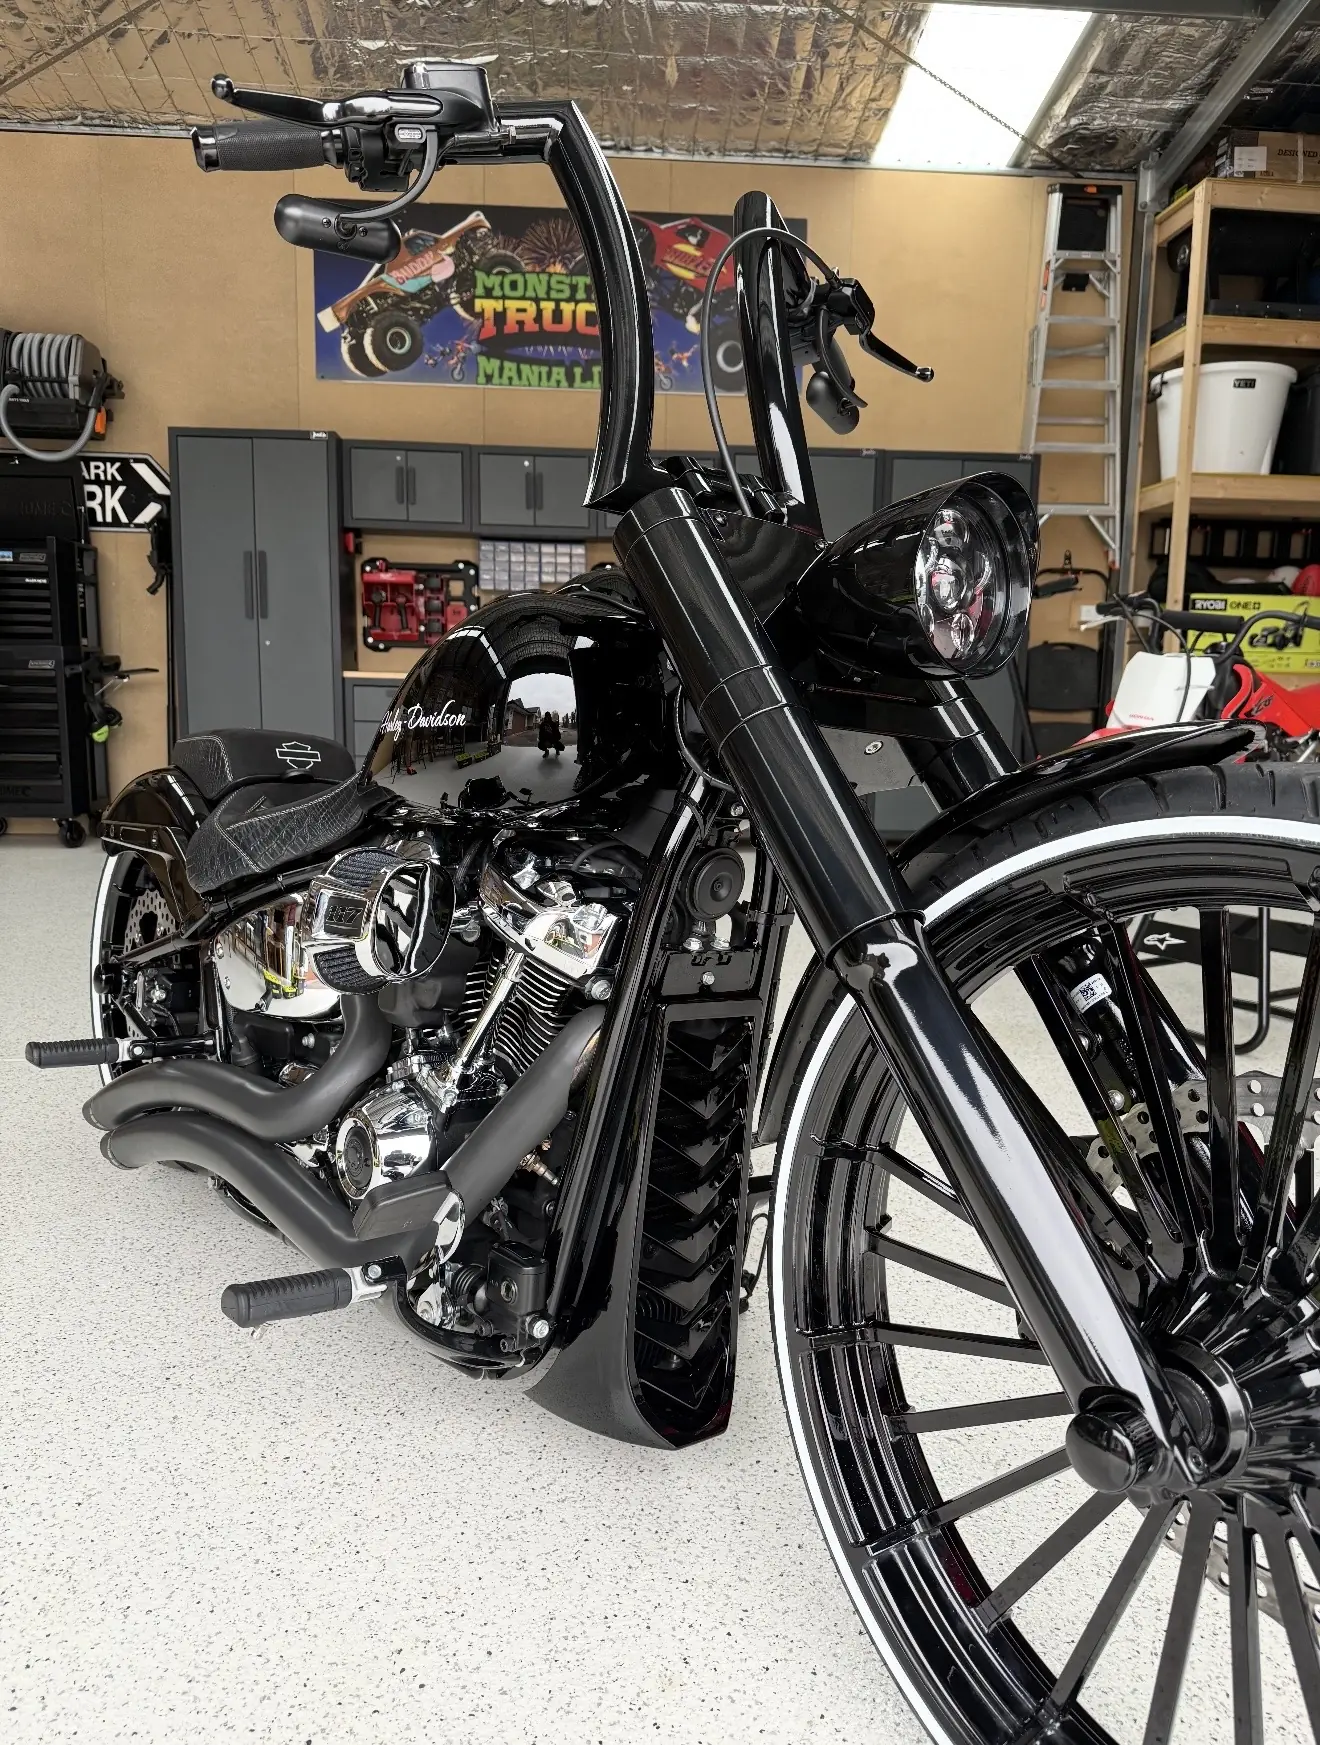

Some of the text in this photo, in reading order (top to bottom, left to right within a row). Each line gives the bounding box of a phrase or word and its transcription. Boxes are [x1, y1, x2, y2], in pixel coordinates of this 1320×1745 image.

[474, 269, 590, 299] MONST
[474, 298, 599, 340] TRUC
[476, 354, 602, 388] MANIA LI
[1234, 379, 1255, 388] YETI
[81, 460, 123, 482] ARK
[83, 484, 130, 523] RK
[1194, 599, 1226, 610] RYOBI
